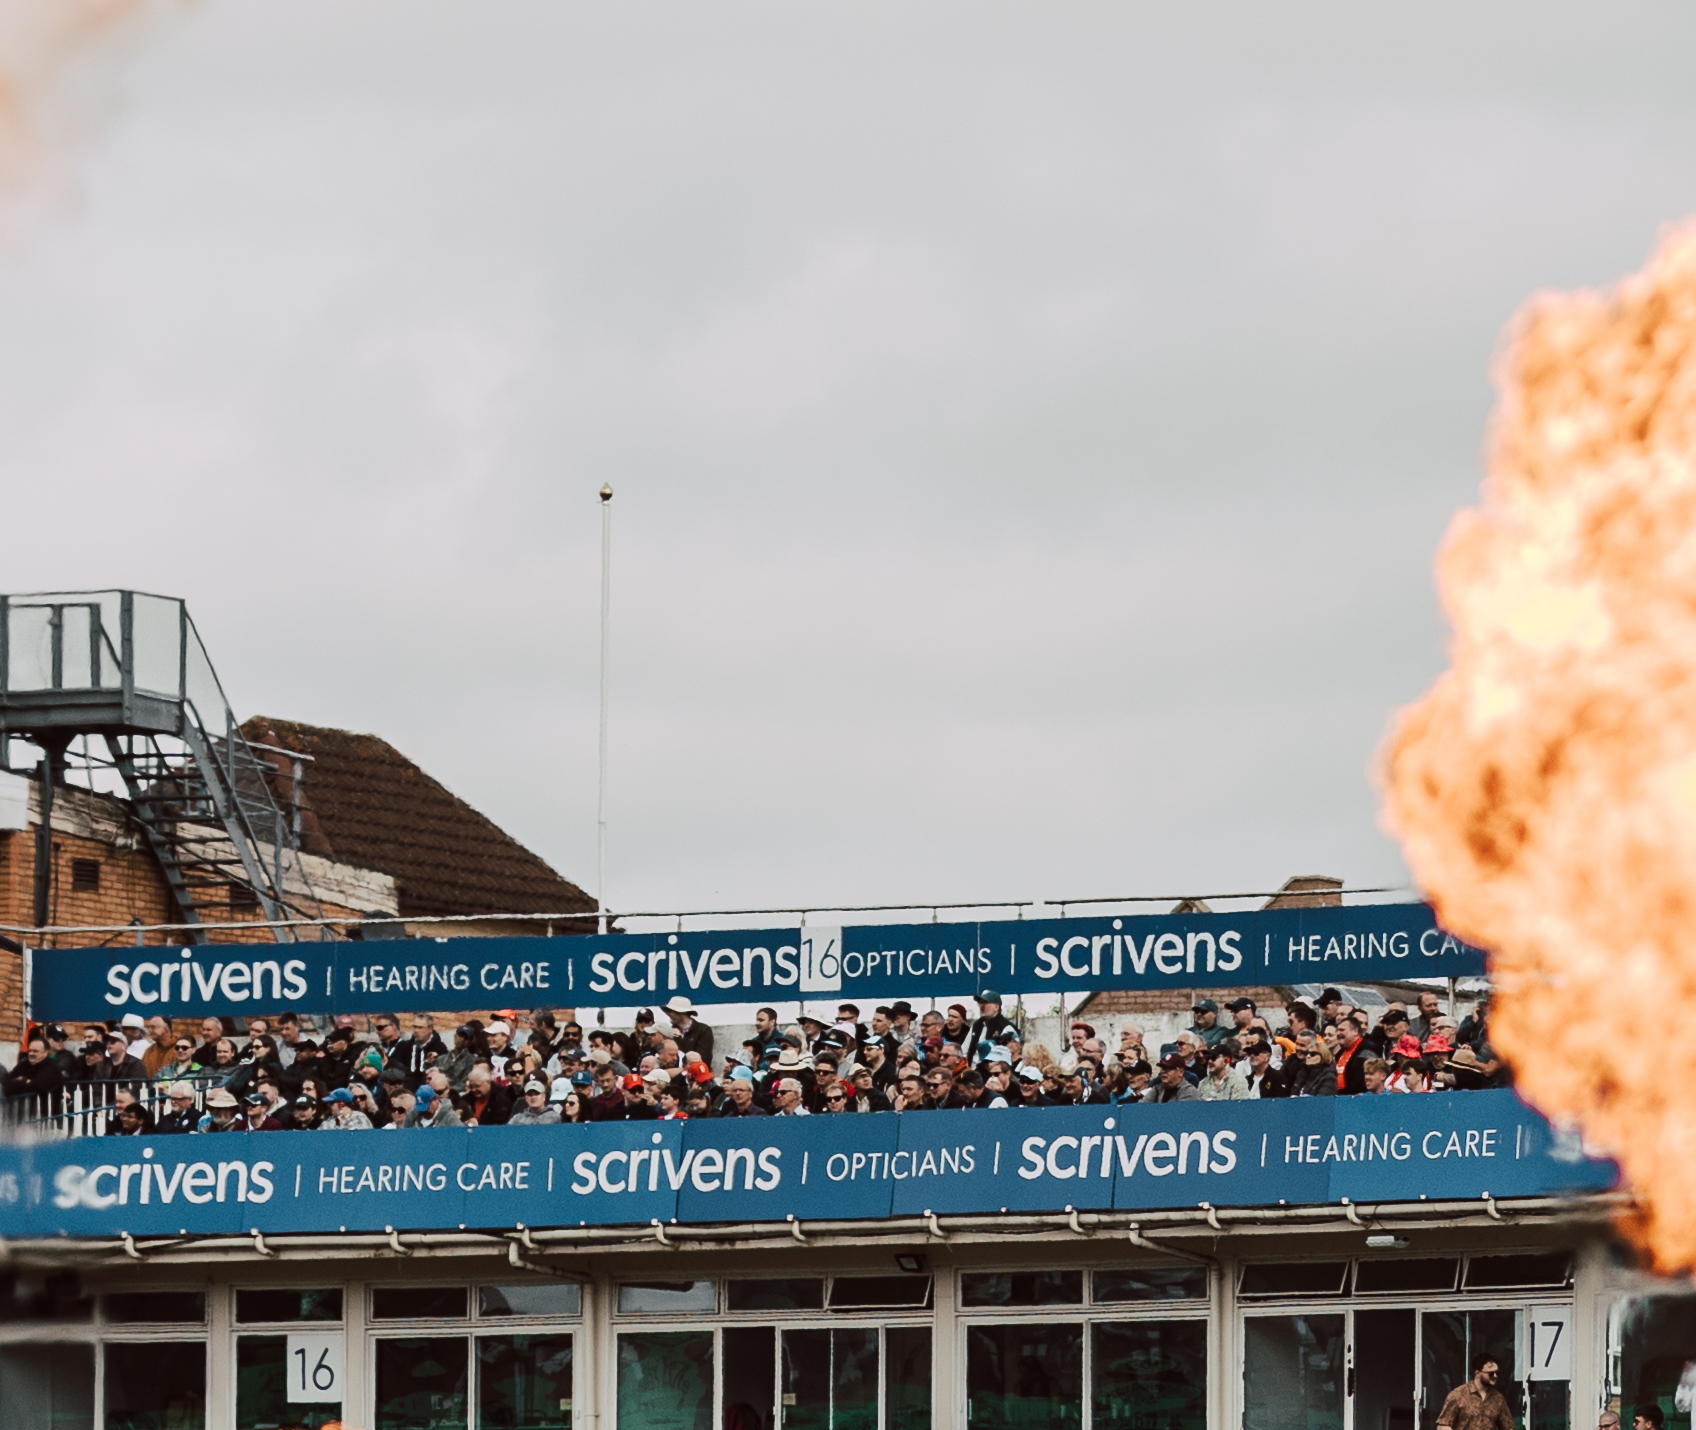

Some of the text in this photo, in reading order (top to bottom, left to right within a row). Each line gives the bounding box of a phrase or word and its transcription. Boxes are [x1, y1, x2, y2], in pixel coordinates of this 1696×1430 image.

[590, 934, 798, 996] scrivens
[803, 938, 839, 979] 16
[842, 947, 992, 979] OPTICIANS
[1034, 918, 1243, 980] scrivens
[1288, 929, 1466, 963] HEARING CA
[105, 948, 307, 1005] scrivens
[349, 962, 549, 992] HEARING CARE
[571, 1133, 782, 1196] scrivens
[826, 1146, 975, 1181] OPTICIANS
[1018, 1117, 1237, 1180] scrivens
[1284, 1129, 1497, 1164] HEARING CARE
[55, 1148, 274, 1208] scrivens
[318, 1161, 530, 1194] HEARING CARE
[1529, 1320, 1565, 1370] 17
[294, 1347, 335, 1391] 16
